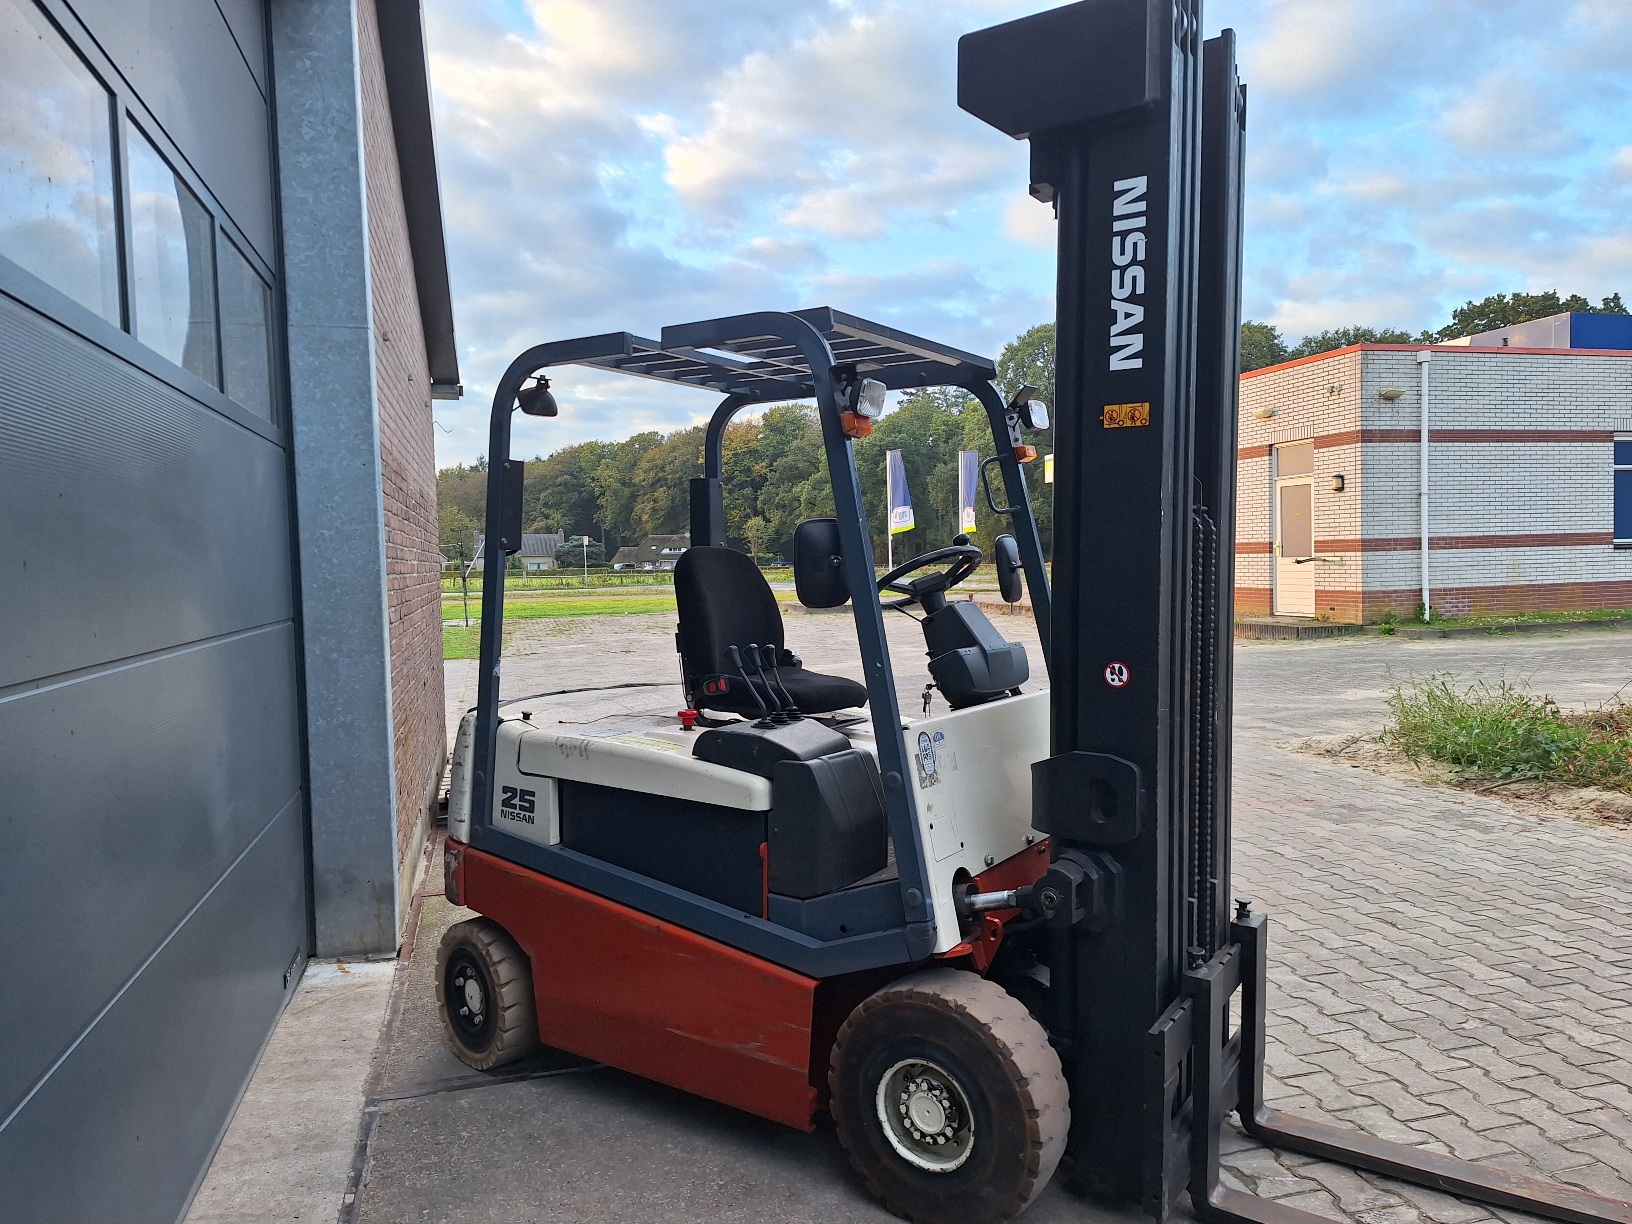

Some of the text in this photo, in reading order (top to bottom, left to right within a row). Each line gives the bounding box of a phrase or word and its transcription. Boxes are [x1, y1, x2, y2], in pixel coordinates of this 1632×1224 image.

[1109, 175, 1148, 371] NISSAN
[501, 785, 536, 814] 25
[500, 808, 535, 825] NISSAN
